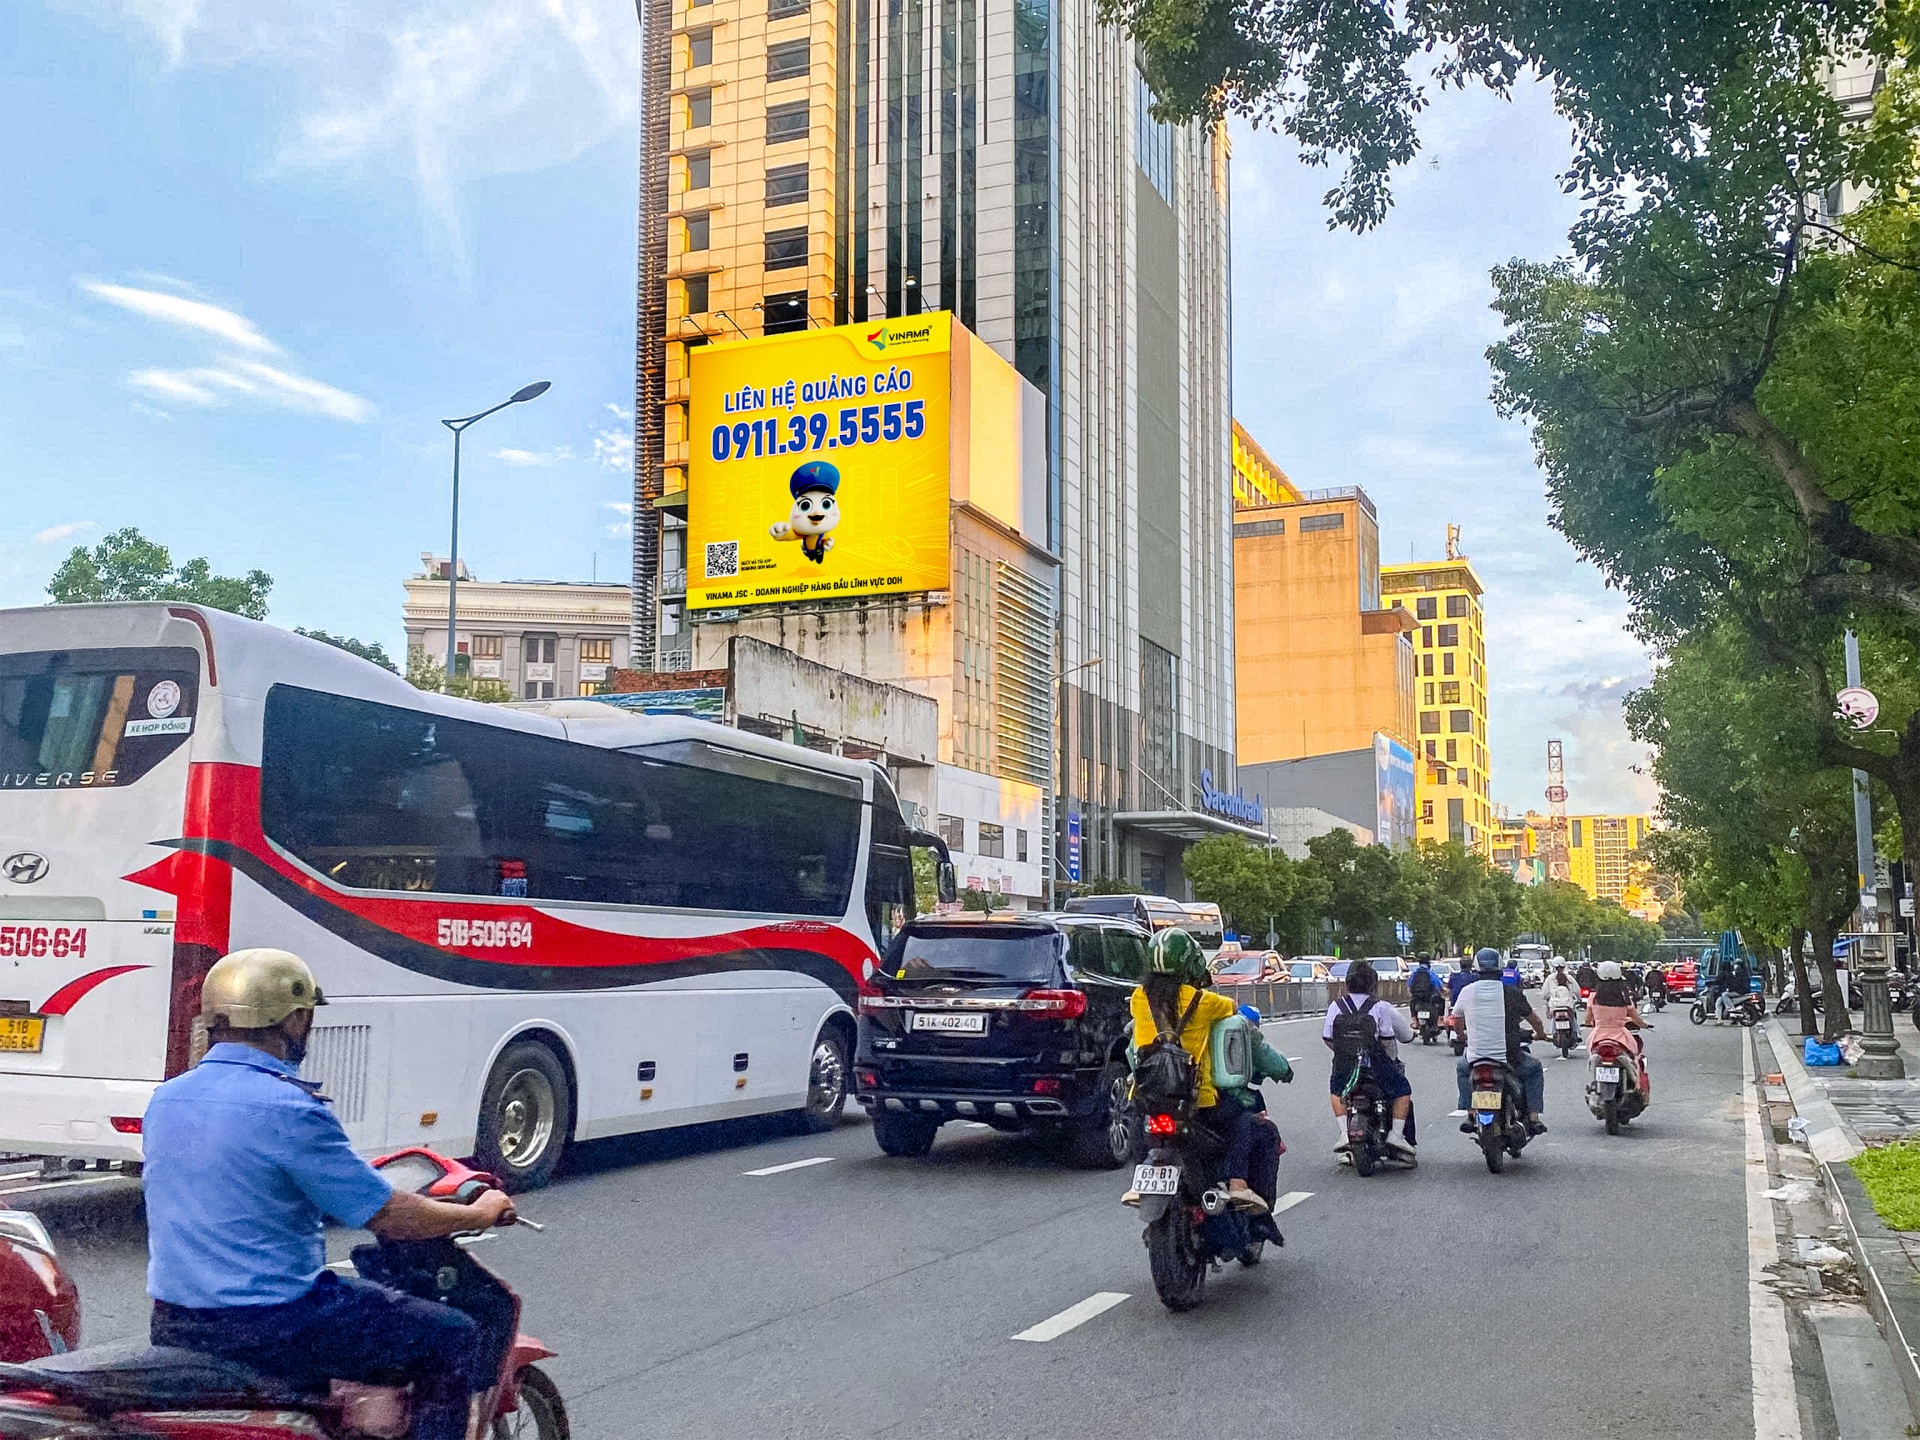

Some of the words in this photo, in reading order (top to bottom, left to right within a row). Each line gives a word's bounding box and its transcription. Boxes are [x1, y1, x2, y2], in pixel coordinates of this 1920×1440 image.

[889, 328, 930, 342] VINAMA
[724, 384, 765, 413] LIÊN
[771, 378, 796, 411] HỆ
[801, 373, 867, 403] QUẢNG
[873, 365, 912, 394] CÁO
[711, 399, 926, 463] 0911.39.5555
[705, 590, 733, 601] VINAMA
[735, 590, 748, 599] JSC
[755, 587, 781, 597] DOANH
[782, 582, 809, 595] NGHIỆP
[811, 581, 832, 592] HÀNG
[850, 578, 868, 588] LĨNH
[870, 576, 885, 589] VỰC
[887, 576, 903, 585] OOH
[130, 724, 141, 733] XE
[8, 1020, 29, 1034] 51B
